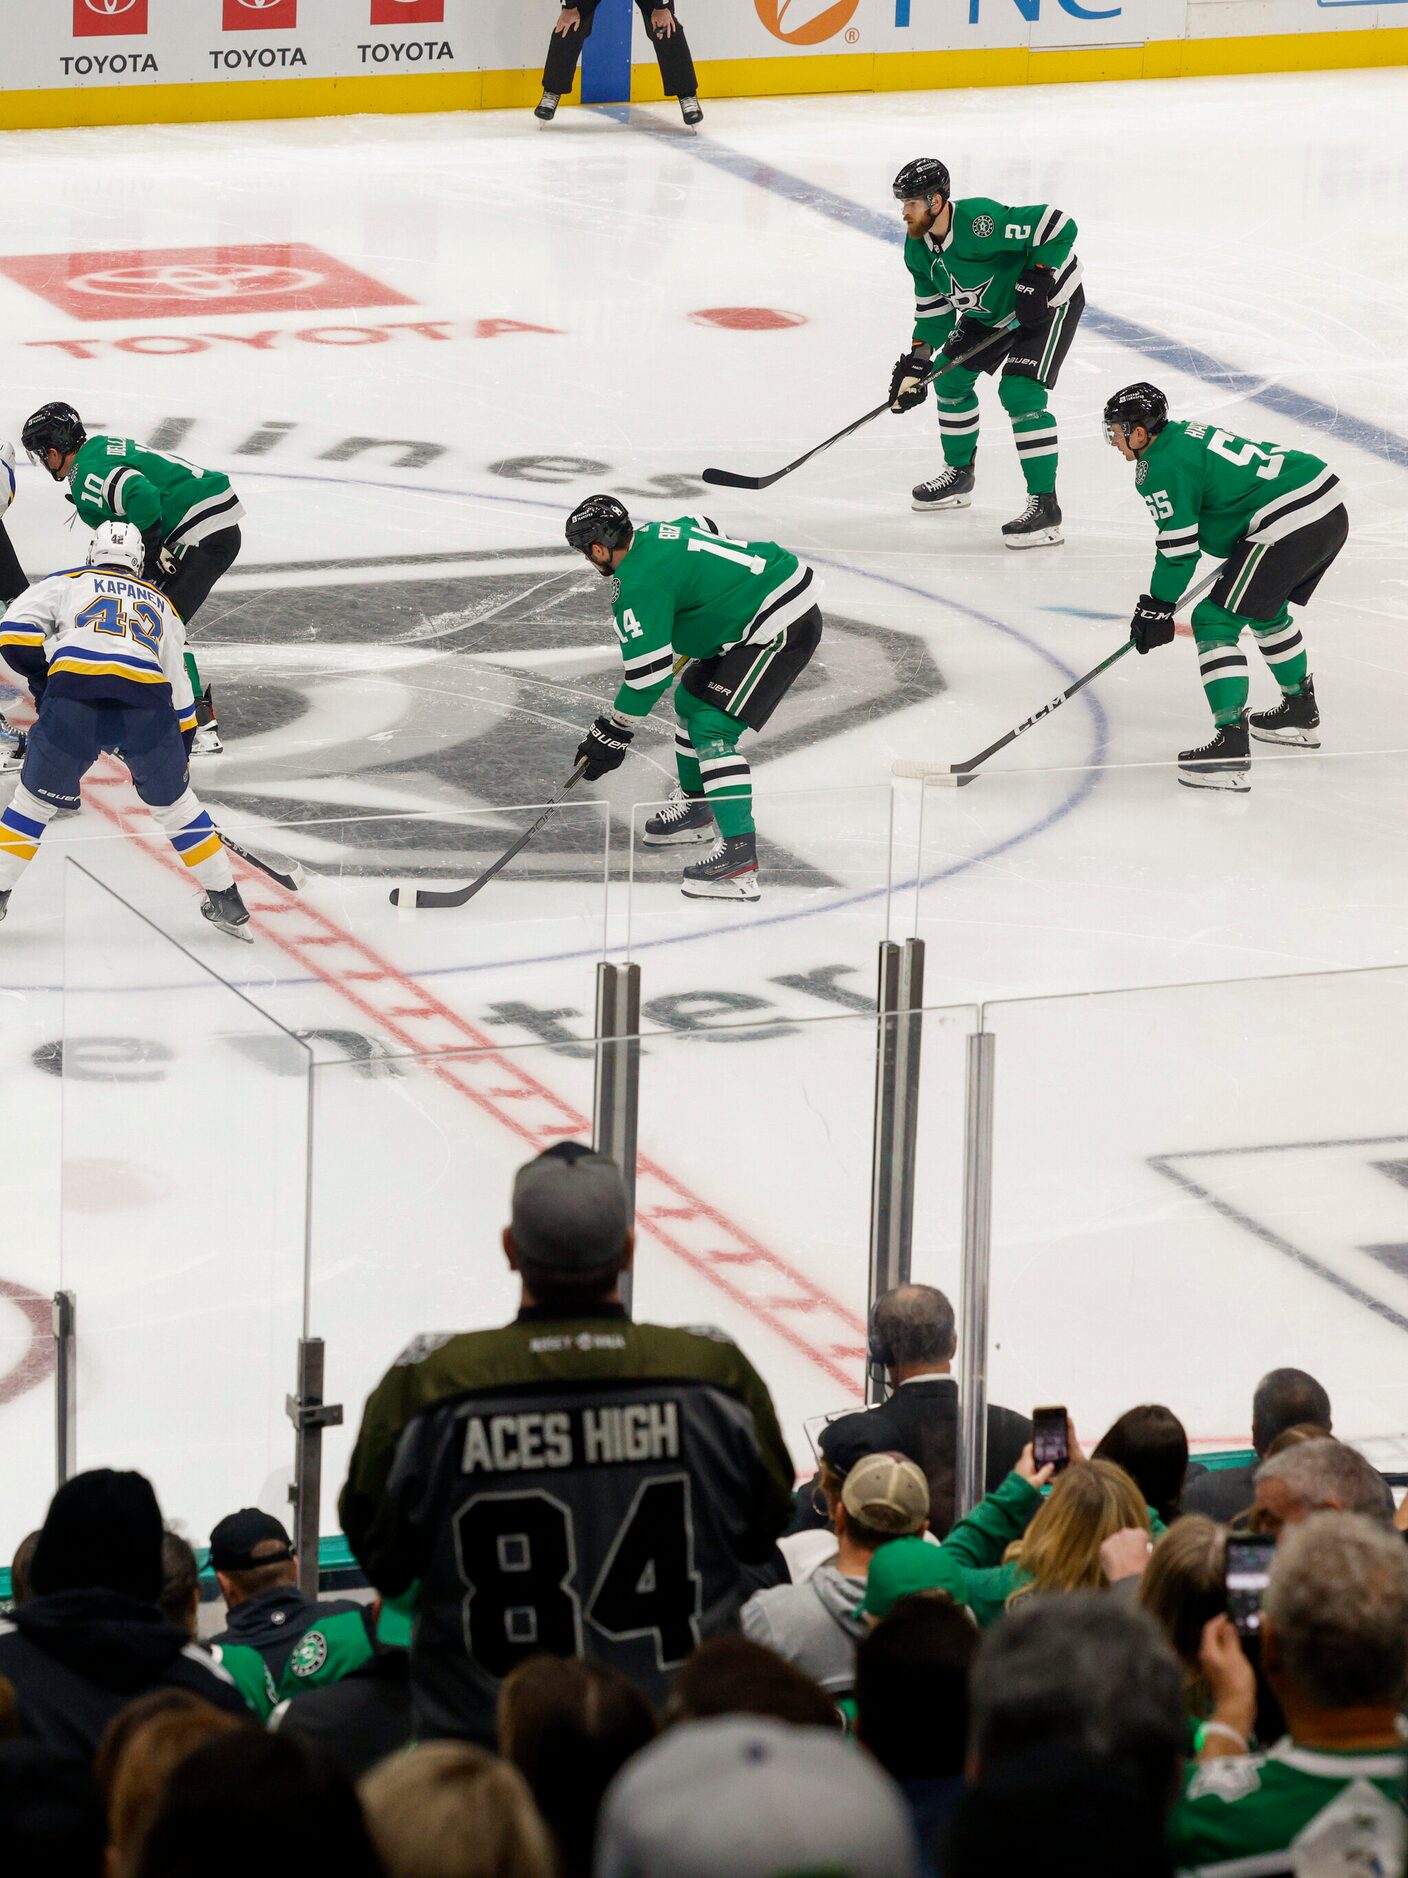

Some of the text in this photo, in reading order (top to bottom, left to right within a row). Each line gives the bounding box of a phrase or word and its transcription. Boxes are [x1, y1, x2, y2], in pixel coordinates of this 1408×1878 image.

[60, 53, 159, 75] TOYOTA
[209, 47, 308, 69] TOYOTA
[357, 41, 454, 63] TOYOTA
[1005, 224, 1031, 240] 2
[21, 317, 567, 360] TOYOTA
[80, 472, 105, 509] 10
[111, 533, 124, 545] 42
[93, 578, 165, 614] KAPANEN
[75, 595, 164, 661] 42
[613, 608, 644, 644] 14
[461, 1402, 680, 1475] ACES HIGH
[451, 1472, 702, 1680] 84
